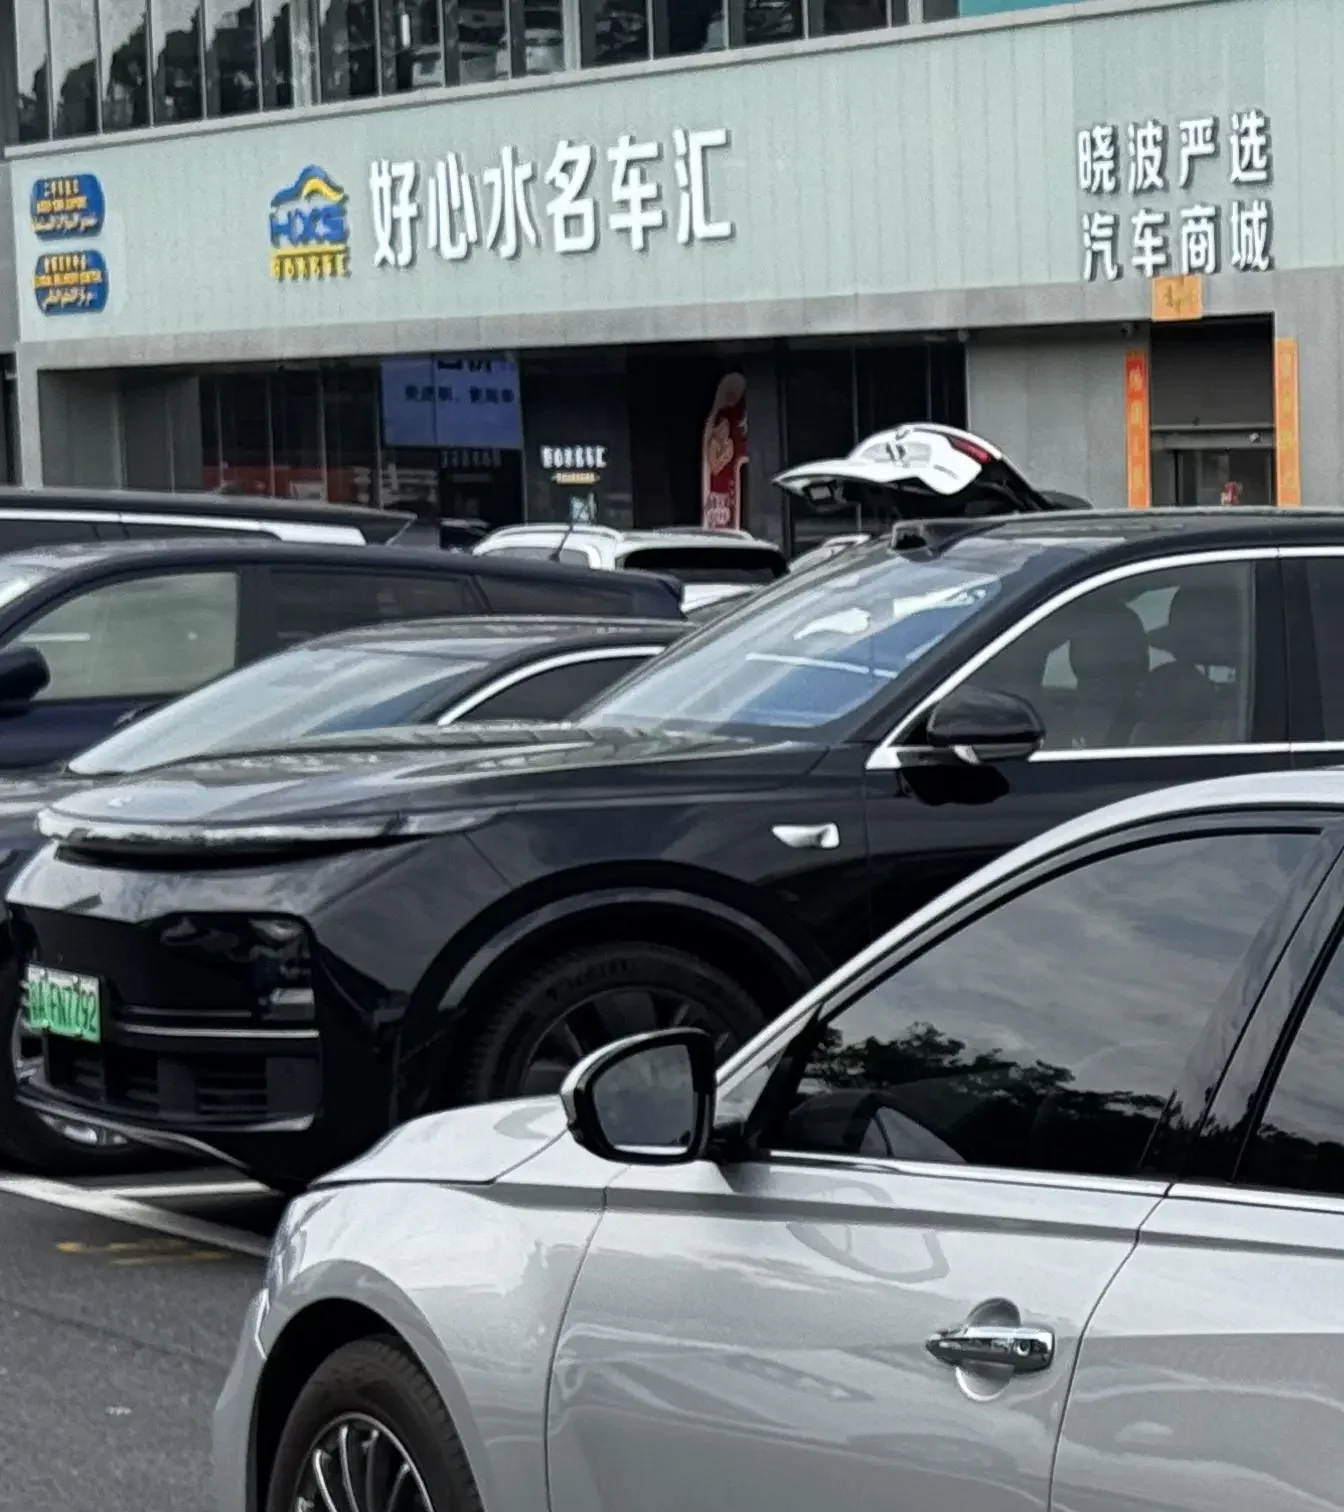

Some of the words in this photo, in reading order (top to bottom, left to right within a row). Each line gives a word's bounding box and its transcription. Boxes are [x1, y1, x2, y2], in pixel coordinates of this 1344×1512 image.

[1077, 109, 1270, 194] 晓波严选
[368, 127, 732, 267] 好心水名车汇
[1081, 199, 1271, 281] 汽车商城
